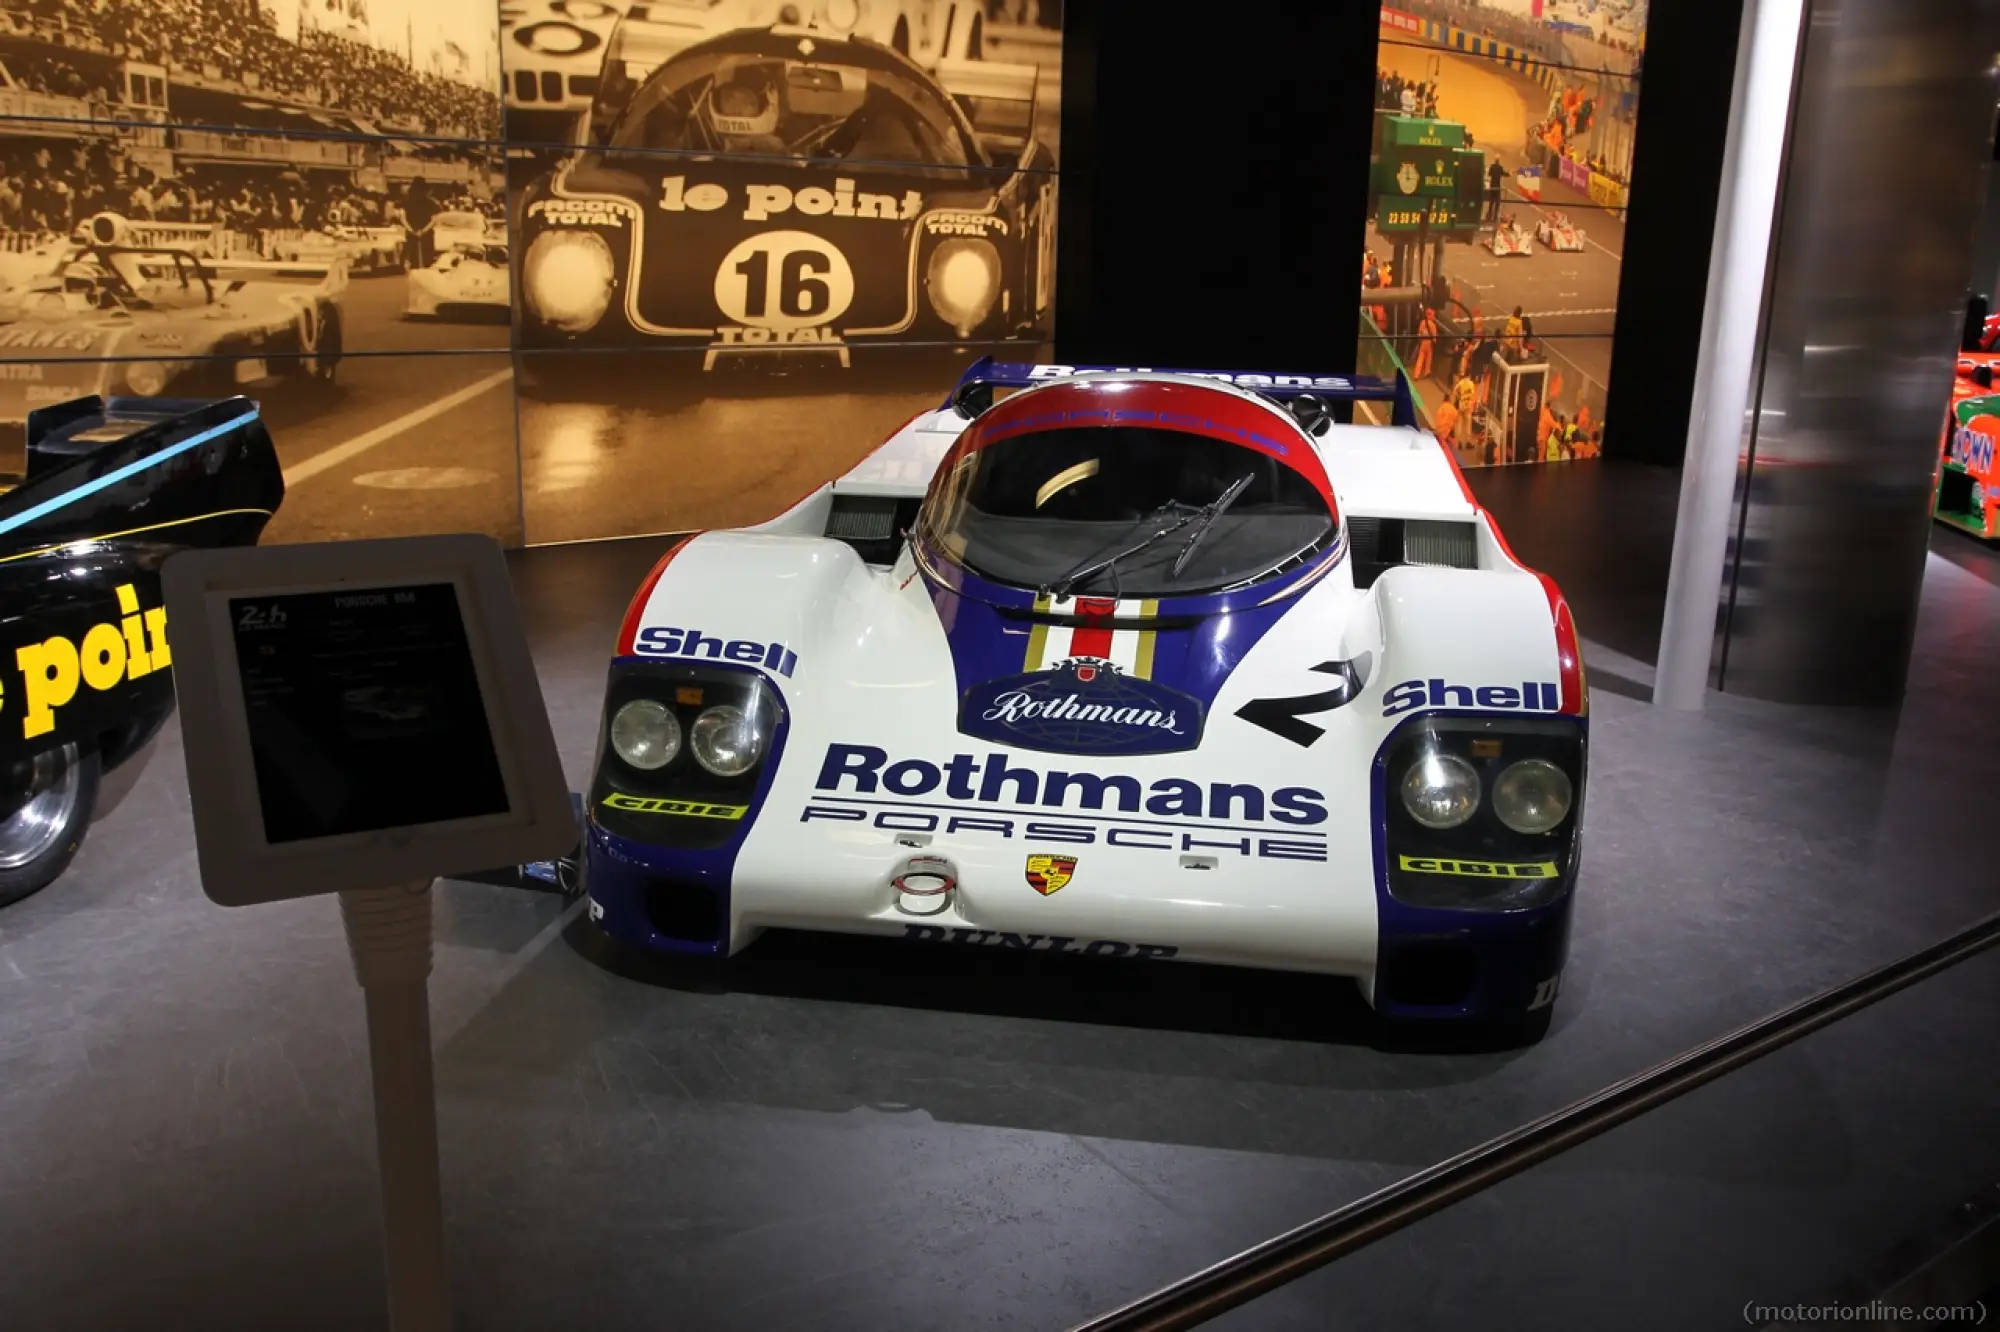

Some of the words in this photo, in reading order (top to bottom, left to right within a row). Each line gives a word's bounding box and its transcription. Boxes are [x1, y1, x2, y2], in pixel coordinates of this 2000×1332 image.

[661, 176, 728, 212] le
[743, 178, 922, 220] point
[1424, 176, 1453, 187] ROLEX
[544, 211, 622, 228] TOTAL
[928, 223, 988, 236] TOTAL
[736, 249, 832, 318] 16
[717, 327, 845, 344] TOTAL
[636, 627, 797, 678] Shell
[982, 690, 1185, 735] Rothmans
[1382, 678, 1557, 717] Shell
[815, 743, 1328, 825] Rothmans
[613, 797, 738, 817] CIBIE
[800, 805, 1328, 862] PORSCHE
[1406, 859, 1544, 877] CIBIE
